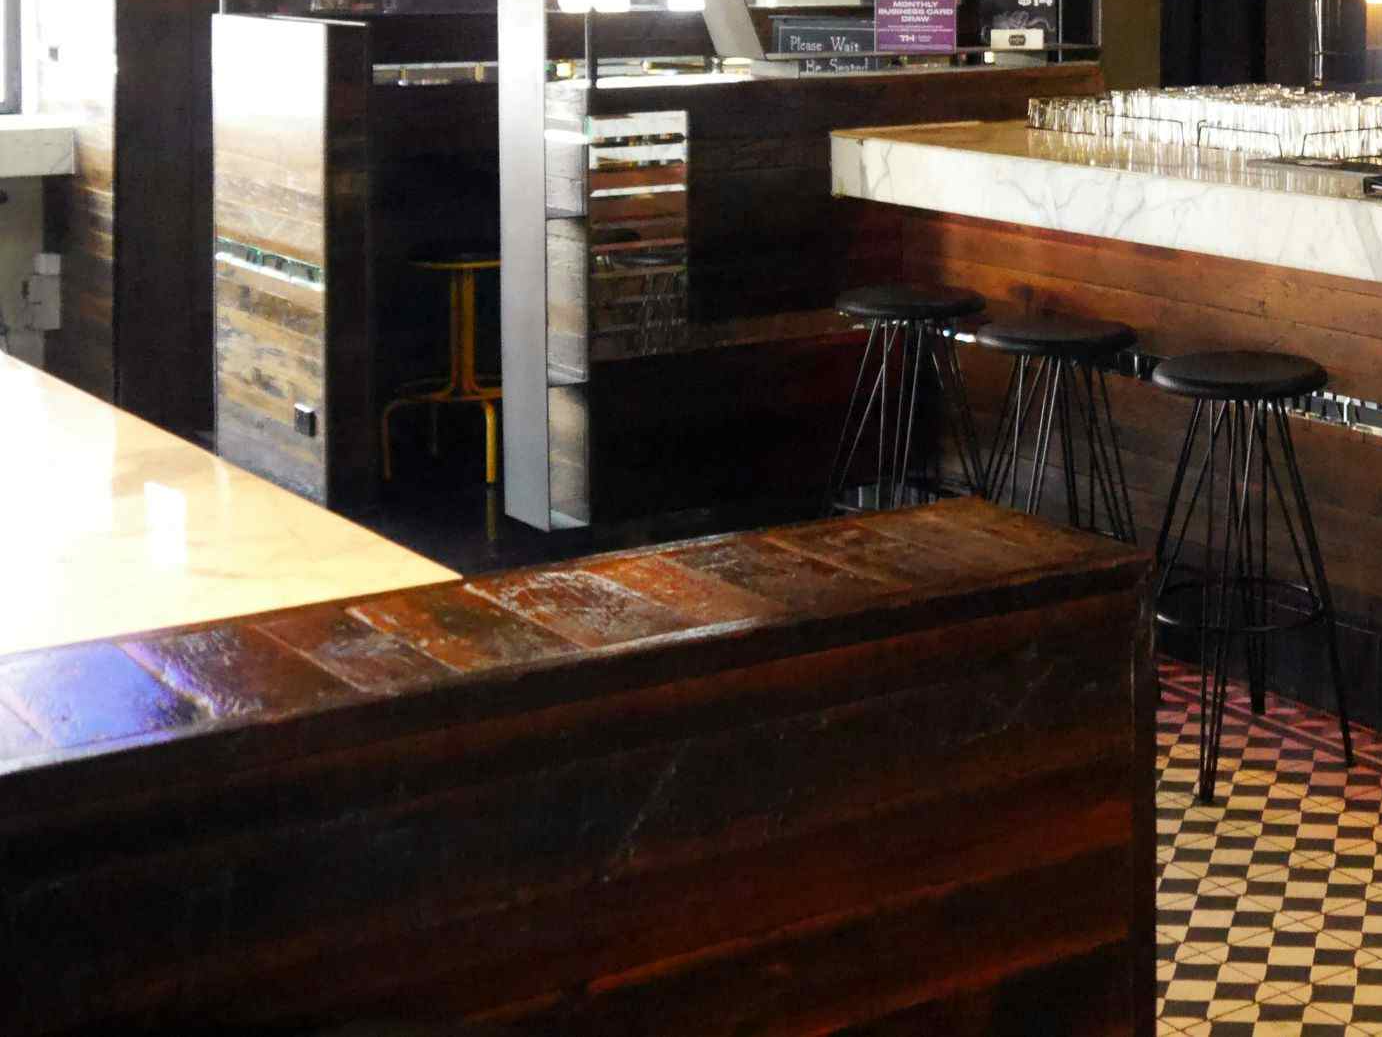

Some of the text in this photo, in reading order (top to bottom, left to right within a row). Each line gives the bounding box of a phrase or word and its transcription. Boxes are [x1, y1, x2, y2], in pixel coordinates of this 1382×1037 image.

[878, 8, 954, 16] BUSINESS CARD
[900, 15, 930, 23] DRAW
[789, 35, 860, 52] Please Wait
